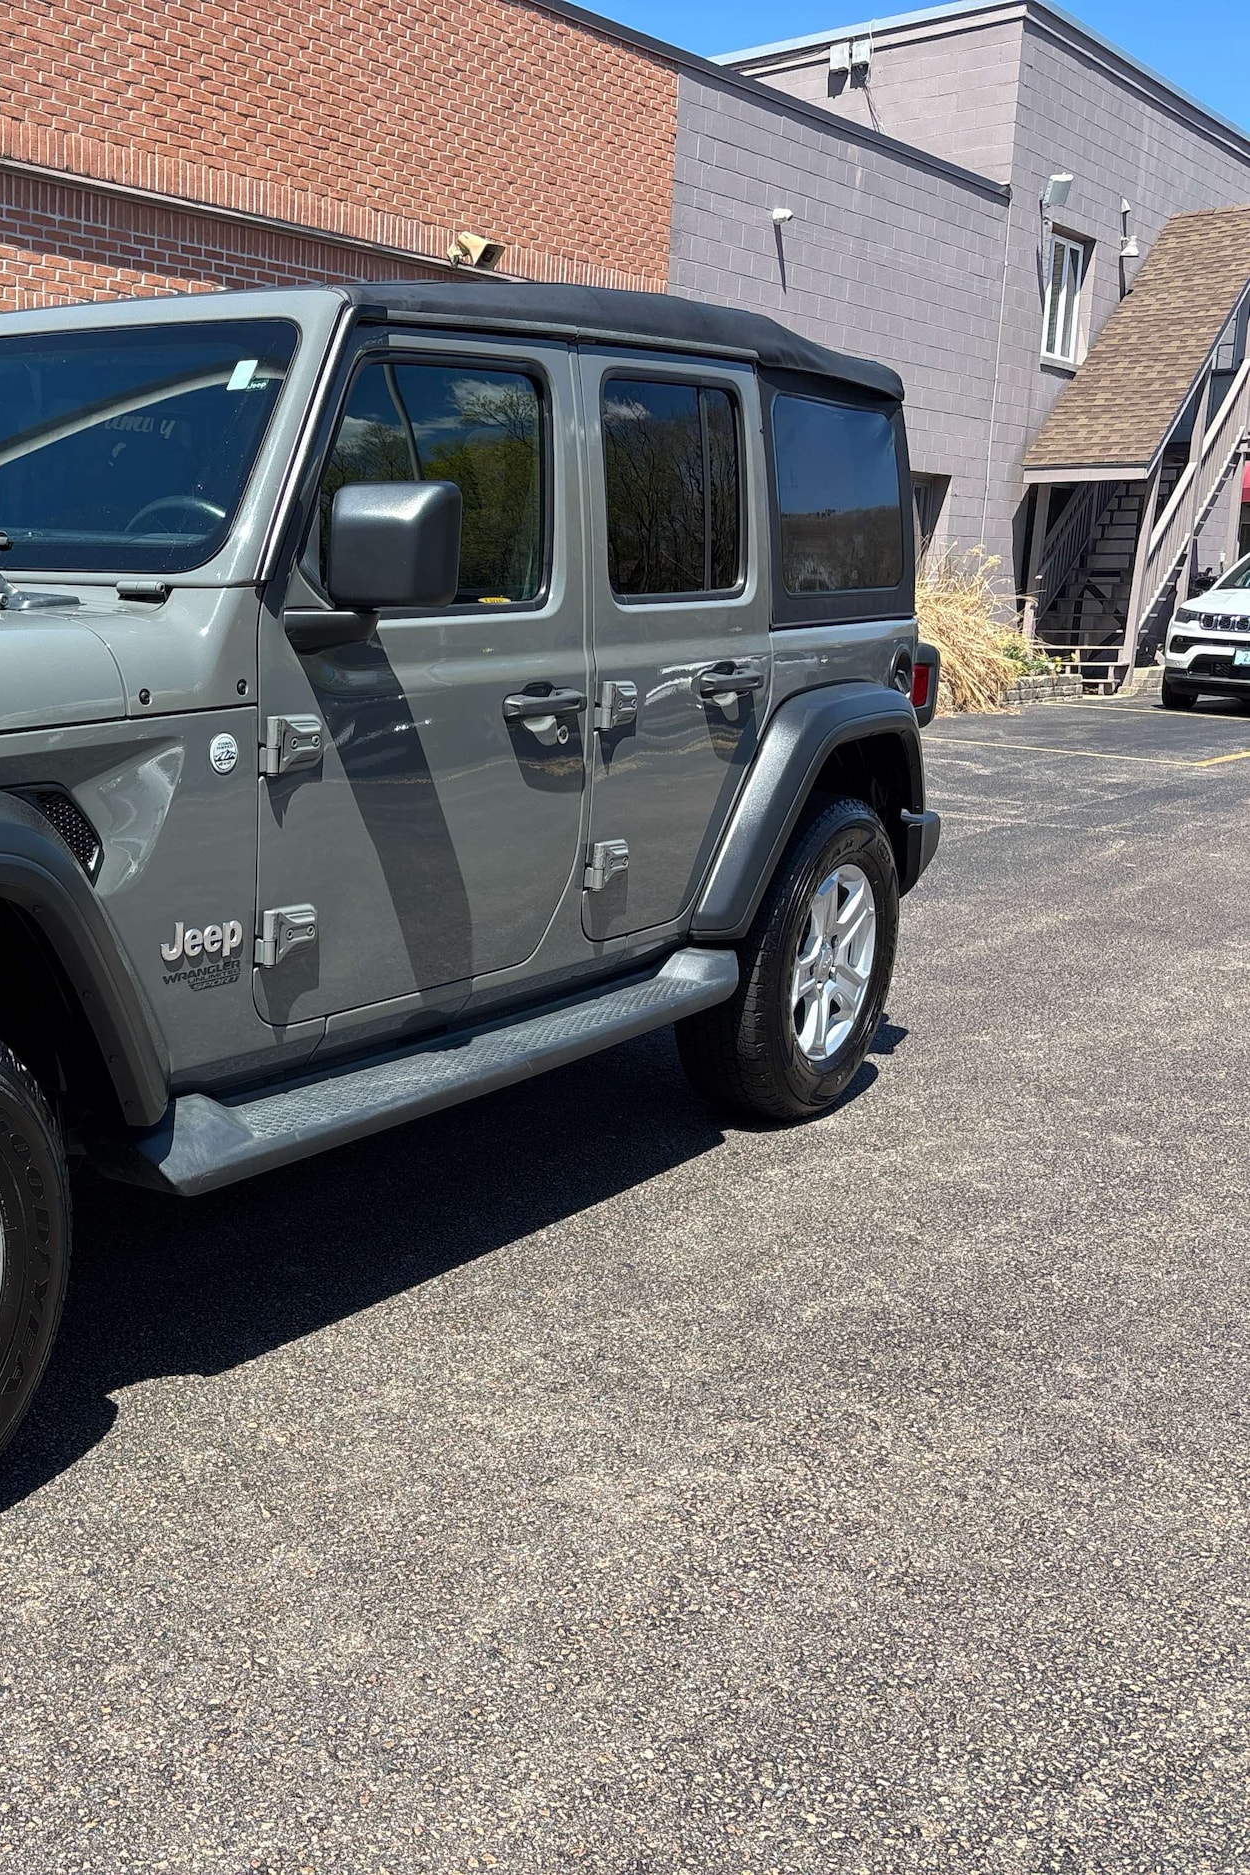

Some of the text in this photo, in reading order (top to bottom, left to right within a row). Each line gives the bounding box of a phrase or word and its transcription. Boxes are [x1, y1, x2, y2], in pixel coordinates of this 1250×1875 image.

[247, 382, 267, 390] Jeep
[160, 920, 242, 961] Jeep
[162, 960, 241, 985] WRANGLER
[188, 968, 241, 984] UNLIMITED
[190, 975, 239, 991] SPORT
